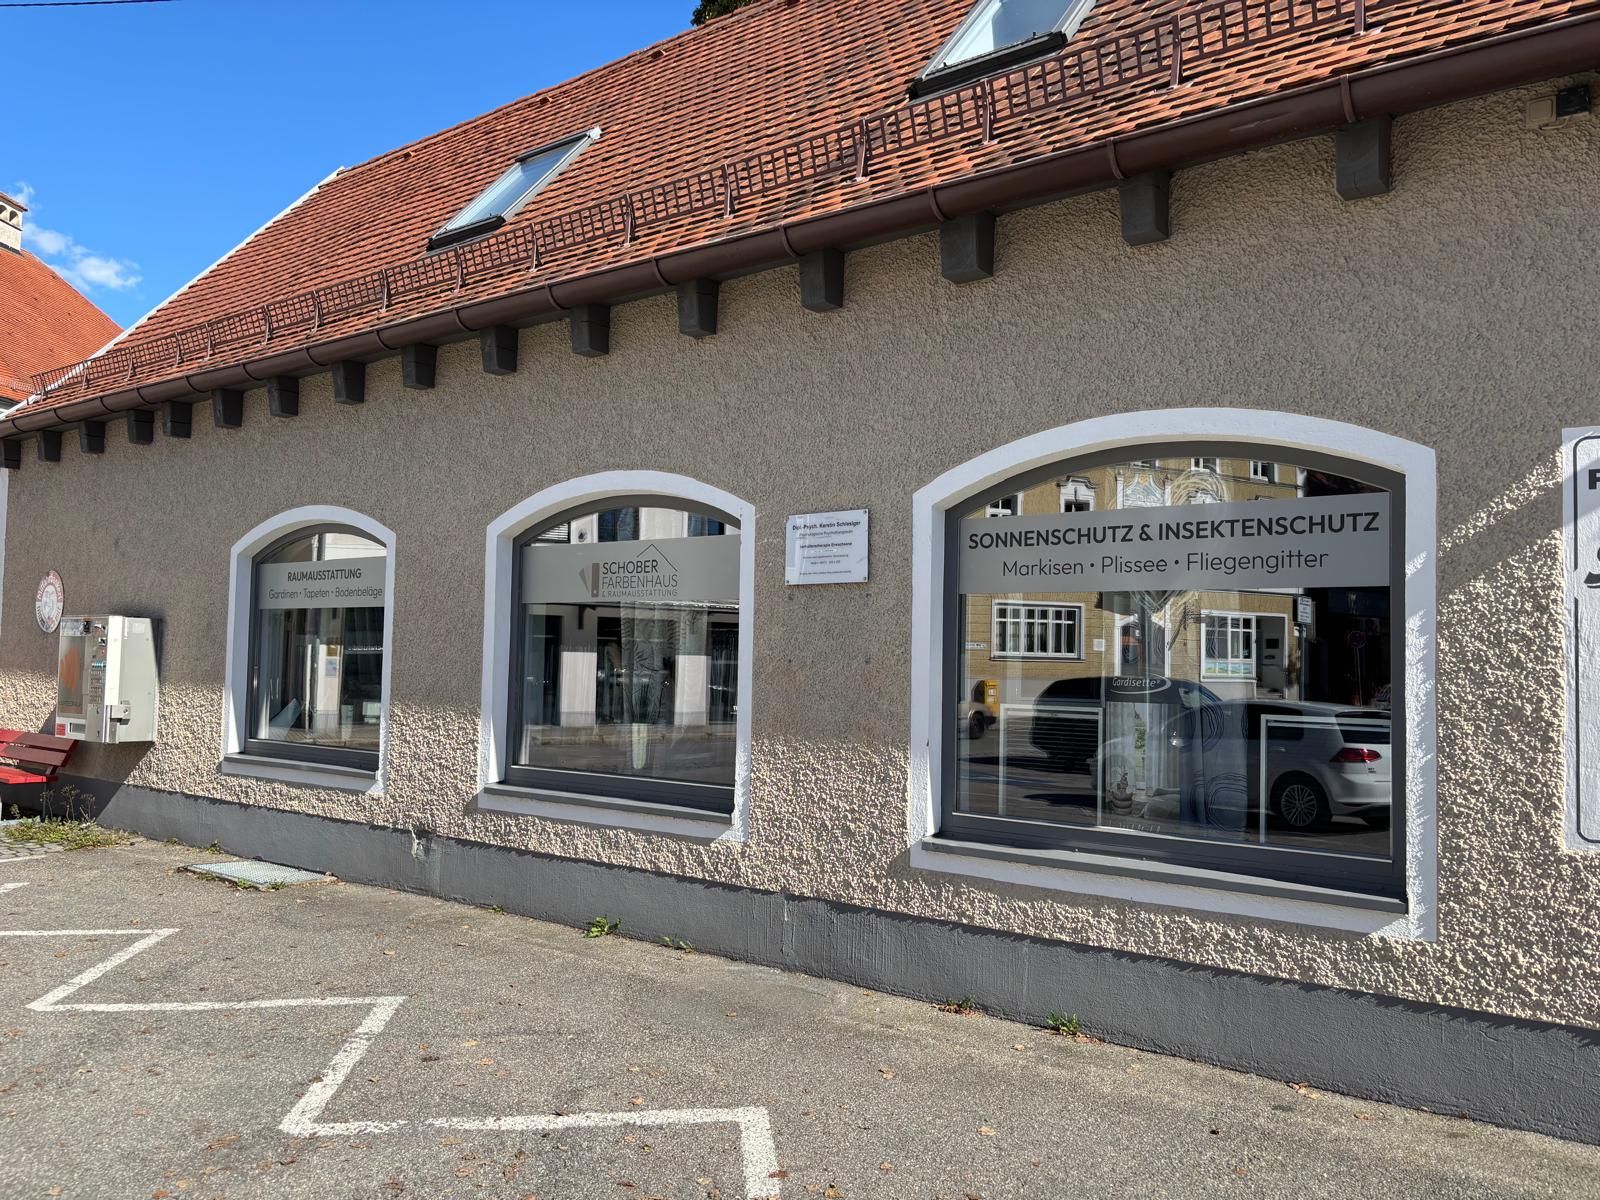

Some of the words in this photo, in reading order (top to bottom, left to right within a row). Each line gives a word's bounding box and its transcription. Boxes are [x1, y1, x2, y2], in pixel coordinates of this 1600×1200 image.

[968, 525, 1134, 550] SONNENSCHUTZ
[1139, 524, 1153, 541] &
[1158, 511, 1380, 541] INSEKTENSCHUTZ
[602, 559, 659, 575] SCHOBER
[1002, 558, 1084, 576] Markisen
[1101, 555, 1168, 574] Plissee
[1187, 550, 1329, 575] Fliegengitter
[287, 568, 362, 582] RAUMAUSSTATTUNG
[601, 574, 678, 590] FARBENHAUS
[268, 588, 299, 600] Gardinen
[303, 587, 330, 600] Tapeten
[334, 585, 383, 599] Bodenbeläge
[607, 588, 678, 598] RAUMAUSSTATTUNG
